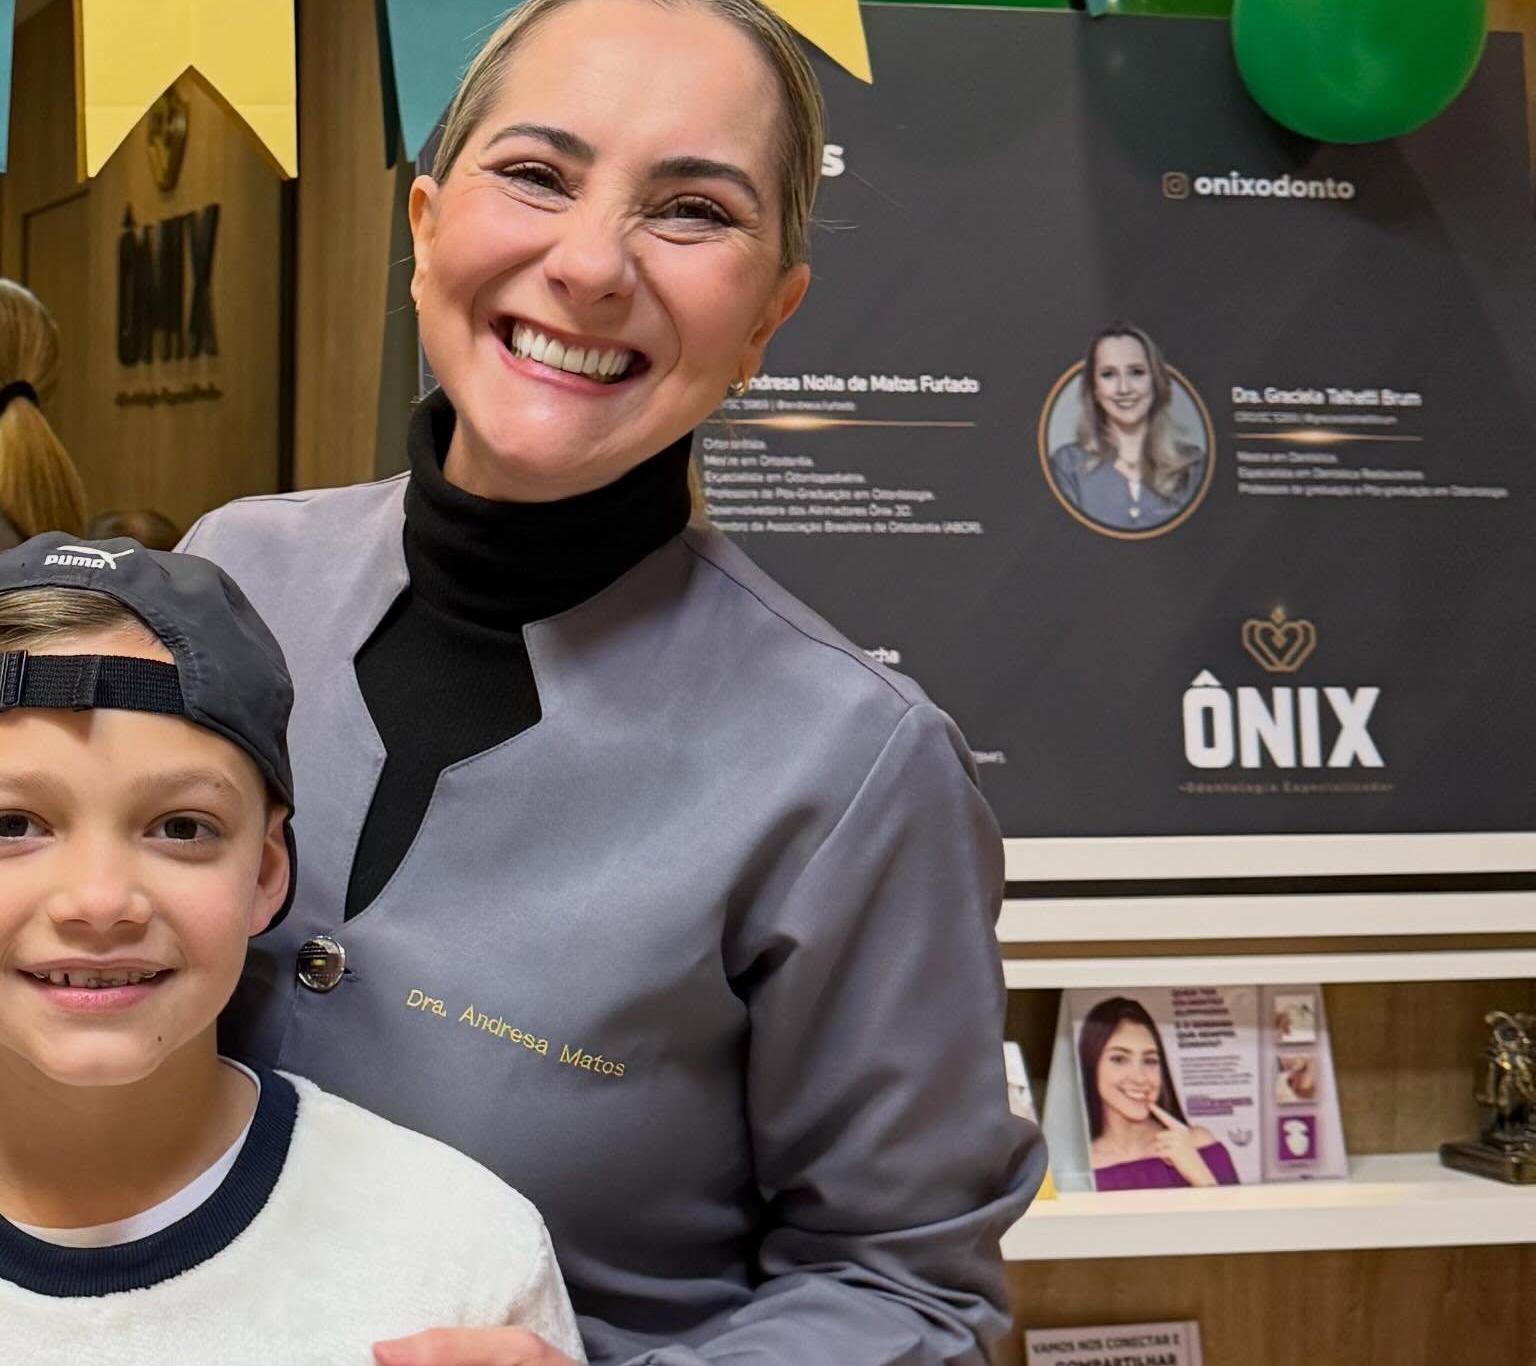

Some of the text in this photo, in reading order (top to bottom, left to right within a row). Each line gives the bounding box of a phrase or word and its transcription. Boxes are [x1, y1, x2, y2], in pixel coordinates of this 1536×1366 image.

[1194, 171, 1355, 200] onixodonto
[747, 374, 800, 391] ndresa
[847, 375, 868, 392] de
[870, 375, 918, 393] Matos
[920, 376, 980, 394] Furtado
[1181, 668, 1386, 769] ÔNIX
[405, 989, 625, 1077] Dra. Andresa Matos
